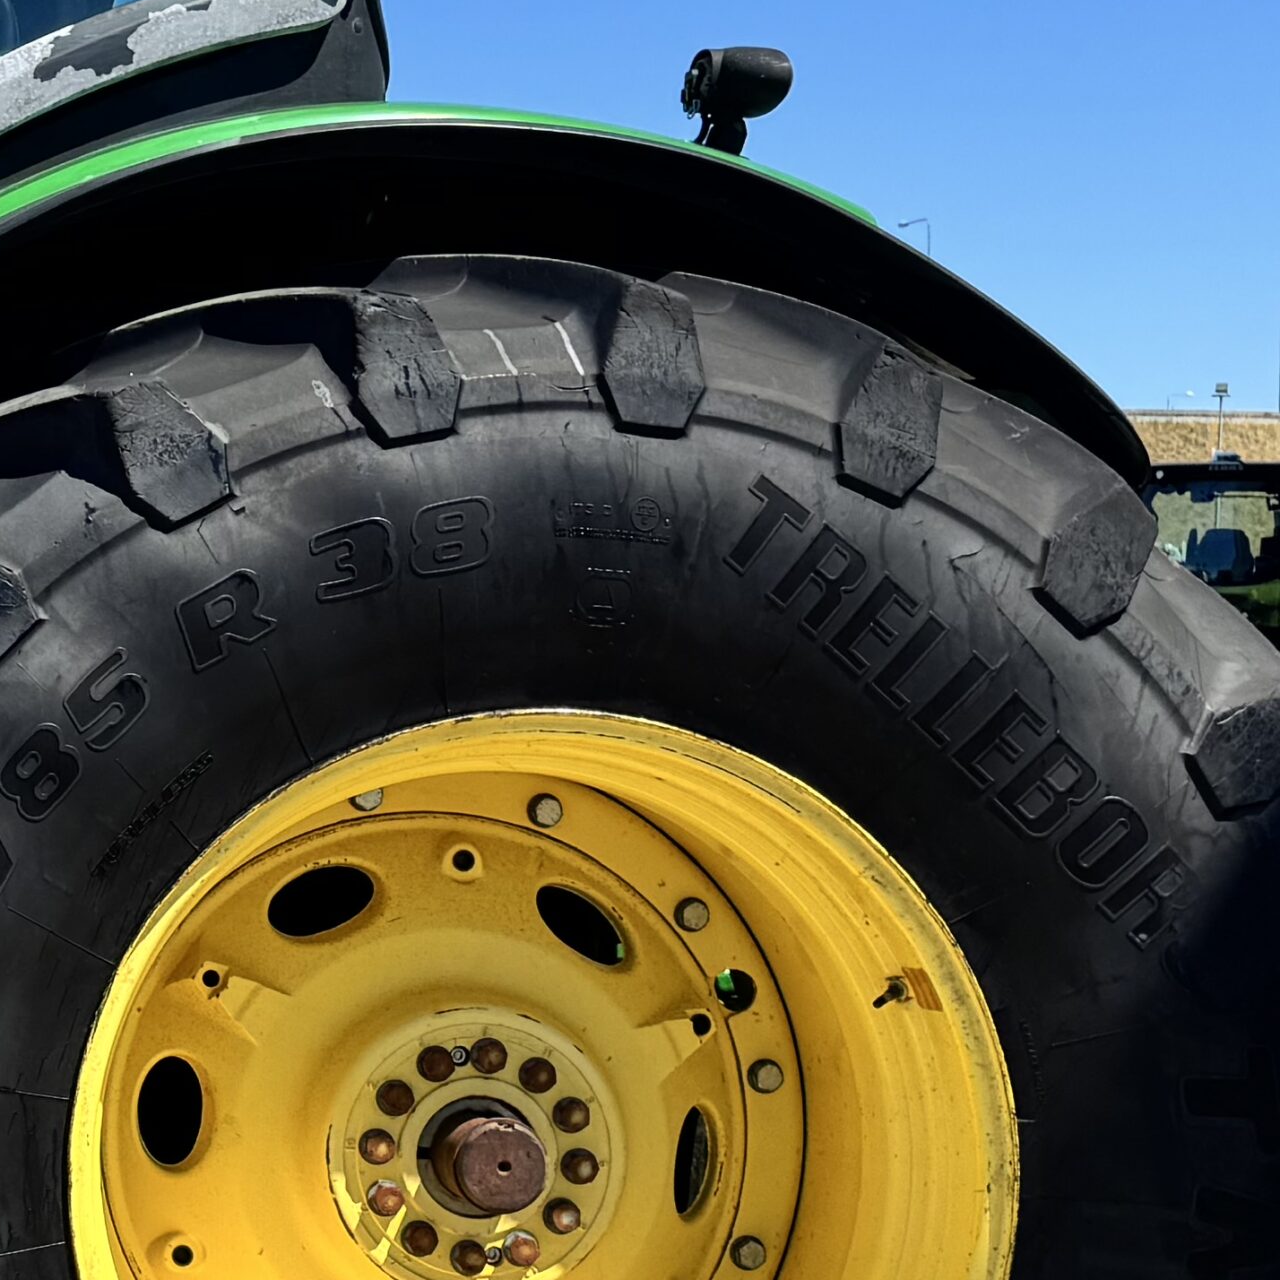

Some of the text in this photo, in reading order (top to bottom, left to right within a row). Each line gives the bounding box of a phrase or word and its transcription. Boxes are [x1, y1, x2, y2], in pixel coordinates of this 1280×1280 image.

[174, 568, 278, 673] R
[308, 496, 497, 604] 38
[722, 472, 1205, 985] TRELLEBOR
